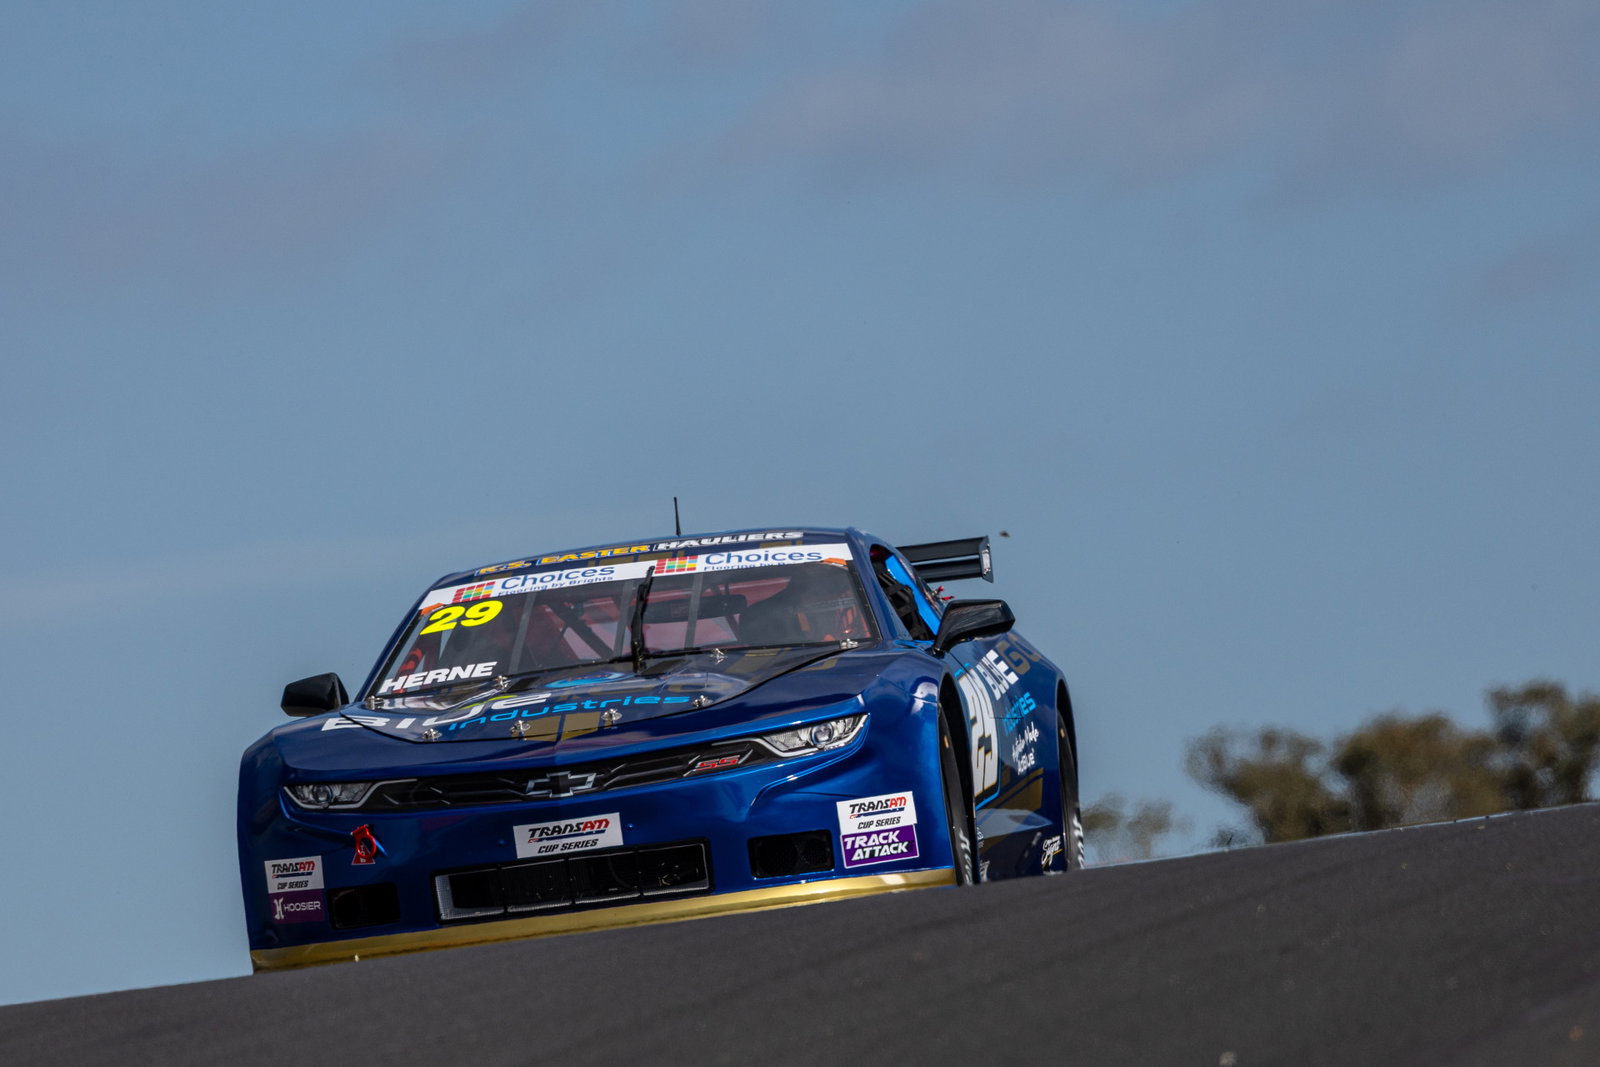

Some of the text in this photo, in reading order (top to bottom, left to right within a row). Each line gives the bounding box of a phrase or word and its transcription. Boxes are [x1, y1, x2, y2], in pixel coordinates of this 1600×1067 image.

[537, 545, 650, 565] EASTER
[653, 532, 804, 551] HAULIERS
[705, 551, 823, 565] Choices
[498, 587, 547, 596] Flooring
[569, 576, 613, 585] Brights
[501, 566, 615, 589] Choices
[420, 600, 503, 635] 29
[379, 661, 497, 694] HERNE
[449, 696, 690, 731] industries
[858, 817, 901, 829] CUP SERIES
[538, 839, 599, 854] CUP SERIES
[844, 831, 900, 849] TRACK
[851, 841, 909, 861] ATTACK
[277, 880, 309, 890] CUP SERIES
[284, 901, 321, 912] HOOSIER
